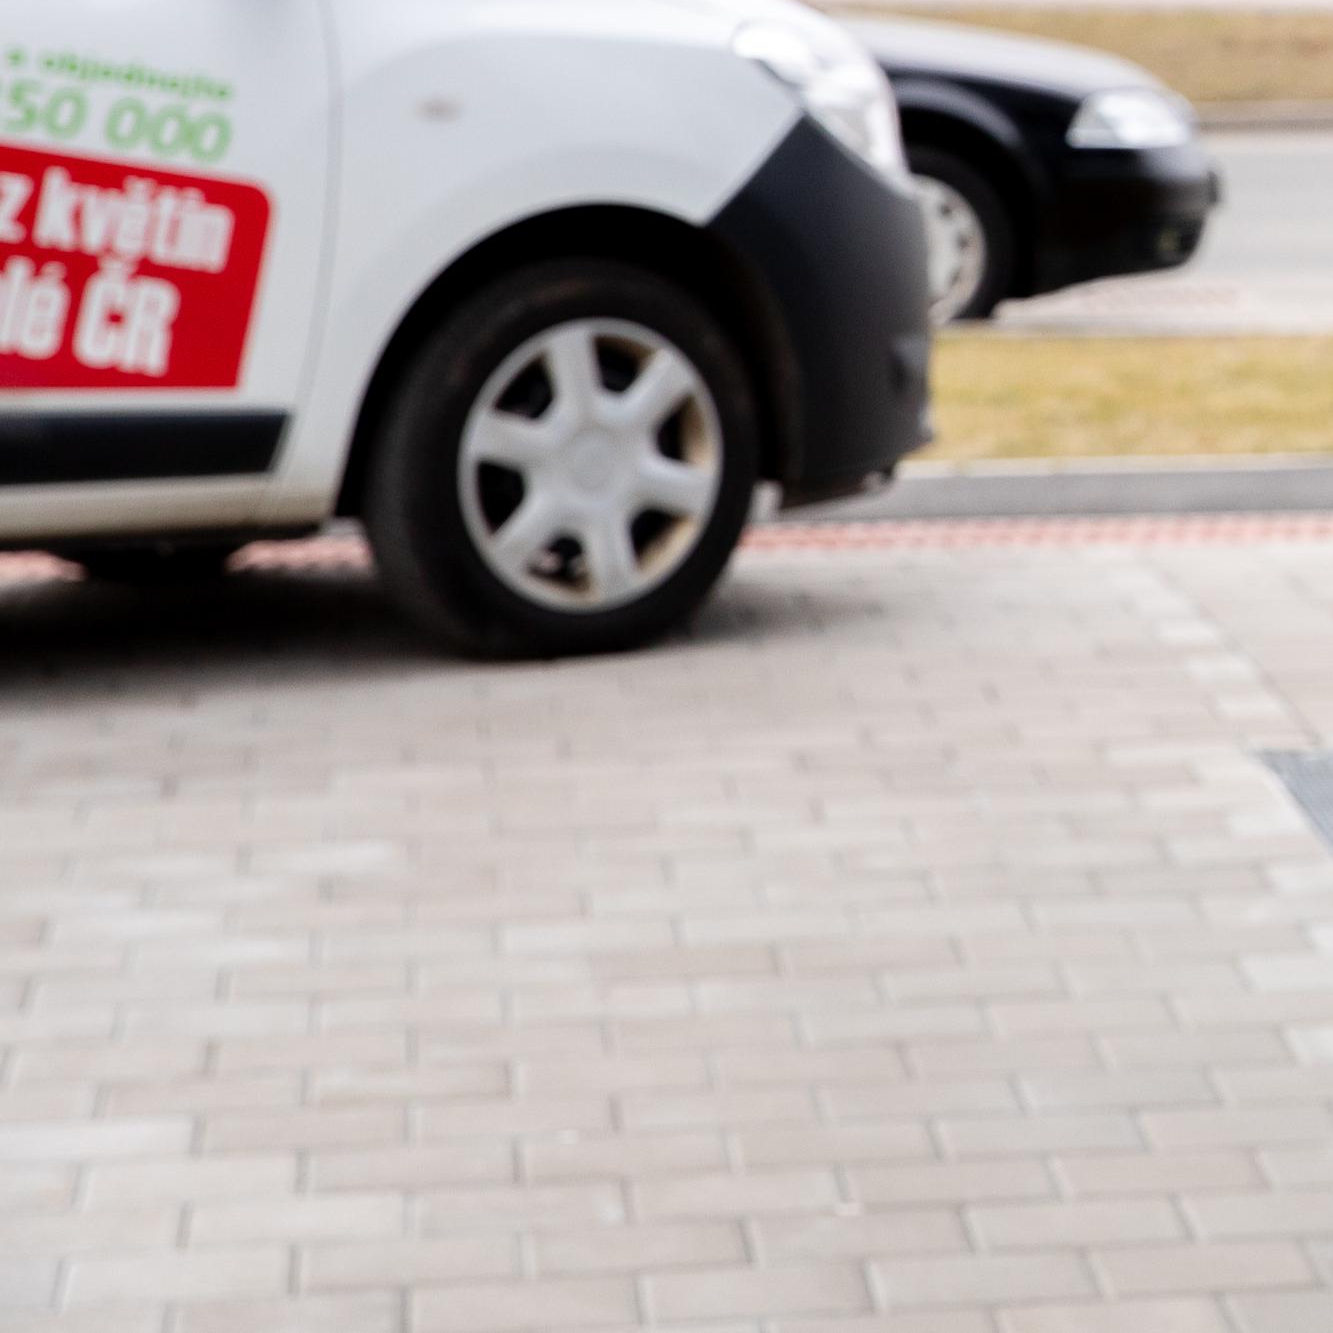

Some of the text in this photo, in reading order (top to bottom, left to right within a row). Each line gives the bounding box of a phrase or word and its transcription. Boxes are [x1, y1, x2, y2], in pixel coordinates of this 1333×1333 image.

[104, 97, 232, 163] 000
[32, 166, 235, 273] květin
[0, 255, 182, 378] lé ČR
